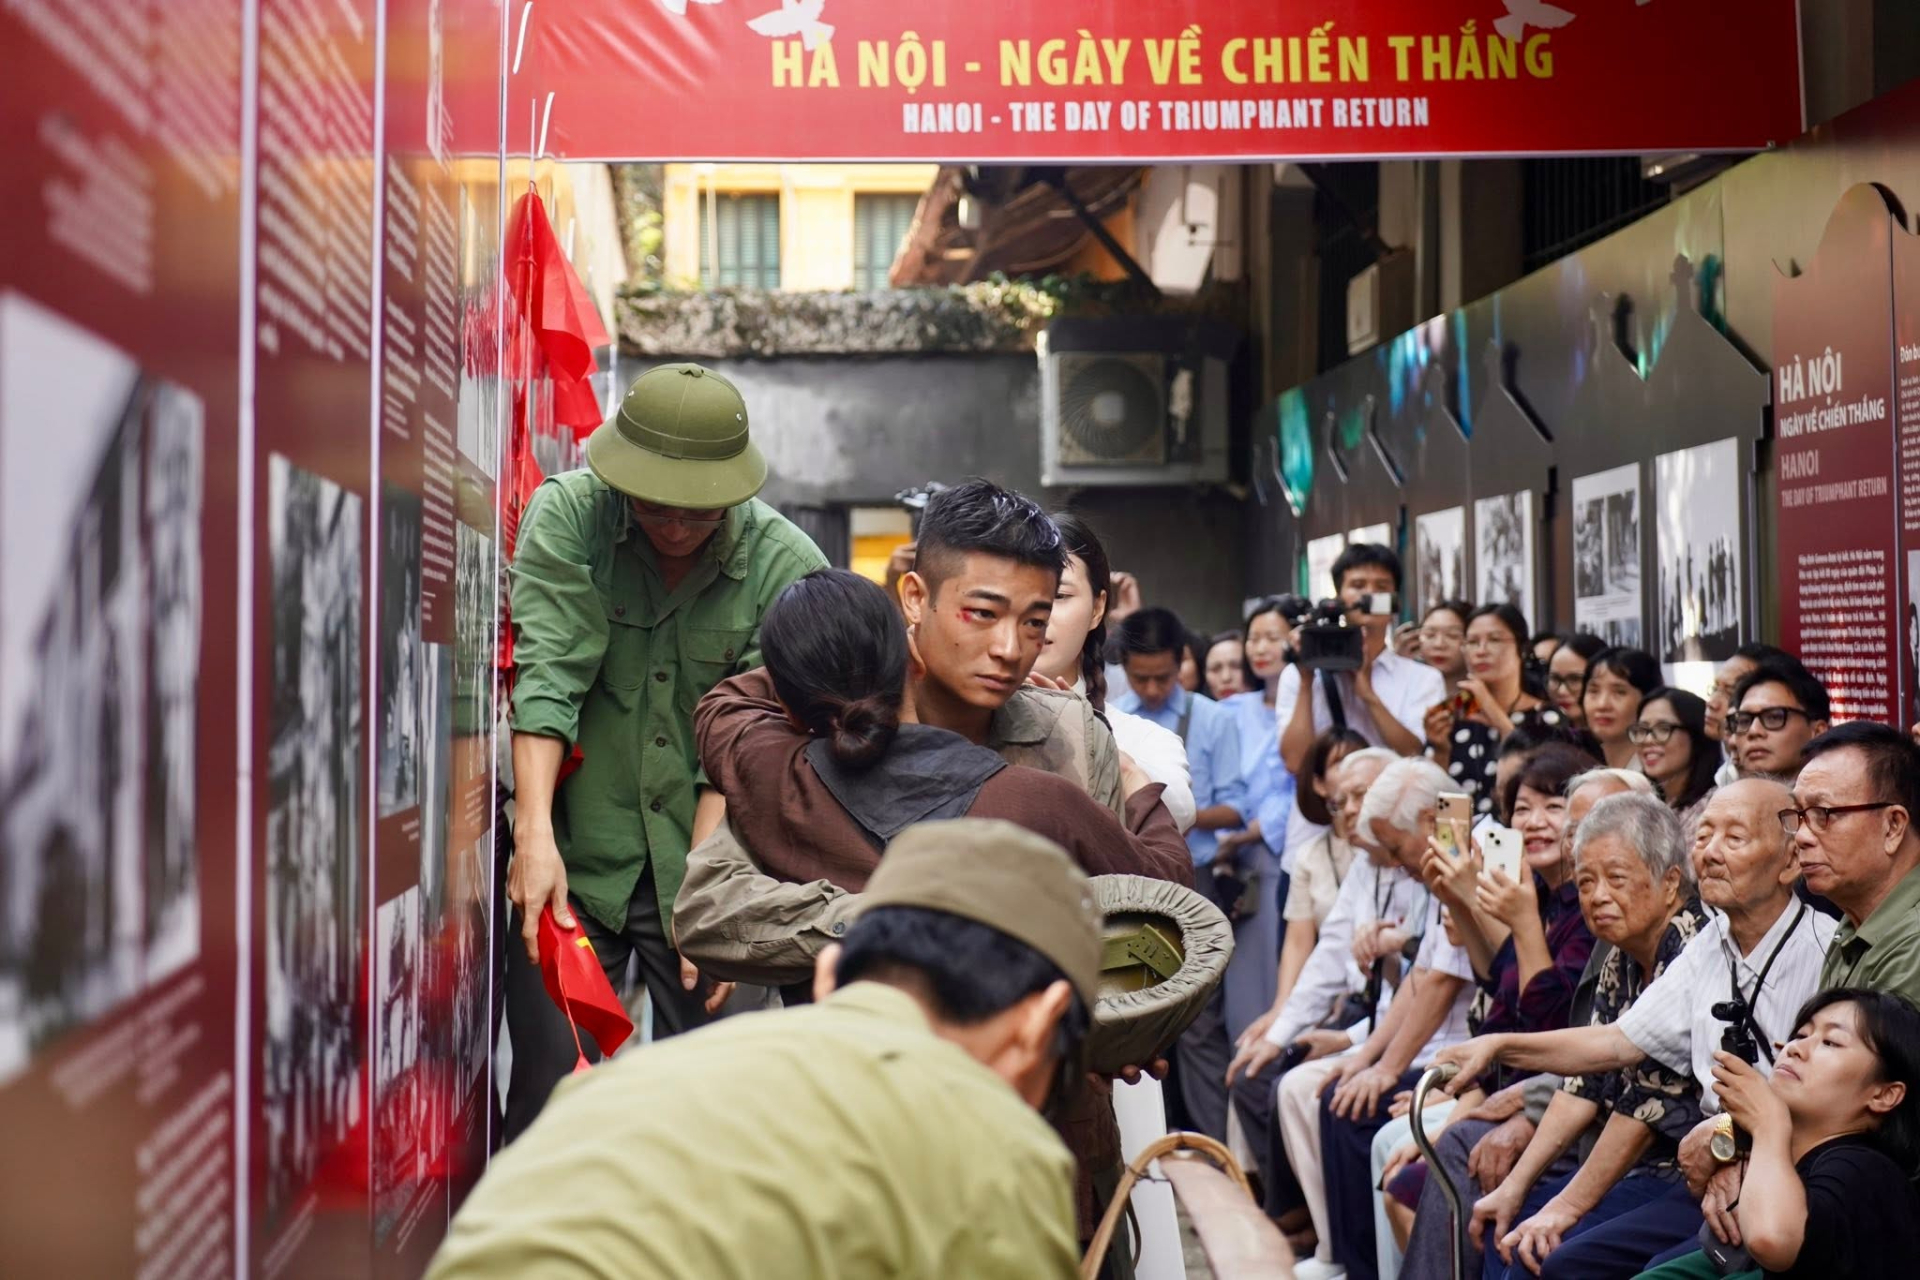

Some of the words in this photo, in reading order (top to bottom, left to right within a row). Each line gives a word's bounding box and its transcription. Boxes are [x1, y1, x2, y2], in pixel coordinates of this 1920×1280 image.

[772, 31, 840, 87] HÀ
[858, 31, 946, 94] NỘI
[965, 62, 980, 72] -
[1000, 29, 1131, 86] NGÀY
[1143, 24, 1202, 85] VỀ
[1221, 21, 1369, 84] CHIẾN
[1388, 19, 1553, 82] THẮNG
[903, 102, 982, 133] HANOI
[1009, 102, 1056, 132] THE
[1065, 101, 1112, 132] DAY
[1120, 101, 1151, 131] OF
[1159, 98, 1323, 131] TRIUMPHANT
[1333, 97, 1429, 127] RETURN
[1780, 354, 1805, 404] HÀ
[1808, 346, 1842, 406] NỘI
[1780, 411, 1804, 439] NGÀY
[1818, 400, 1847, 431] CHIẾN
[1847, 393, 1885, 425] THẮNG
[1781, 449, 1819, 480] HANOI
[1858, 476, 1887, 498] RETURN
